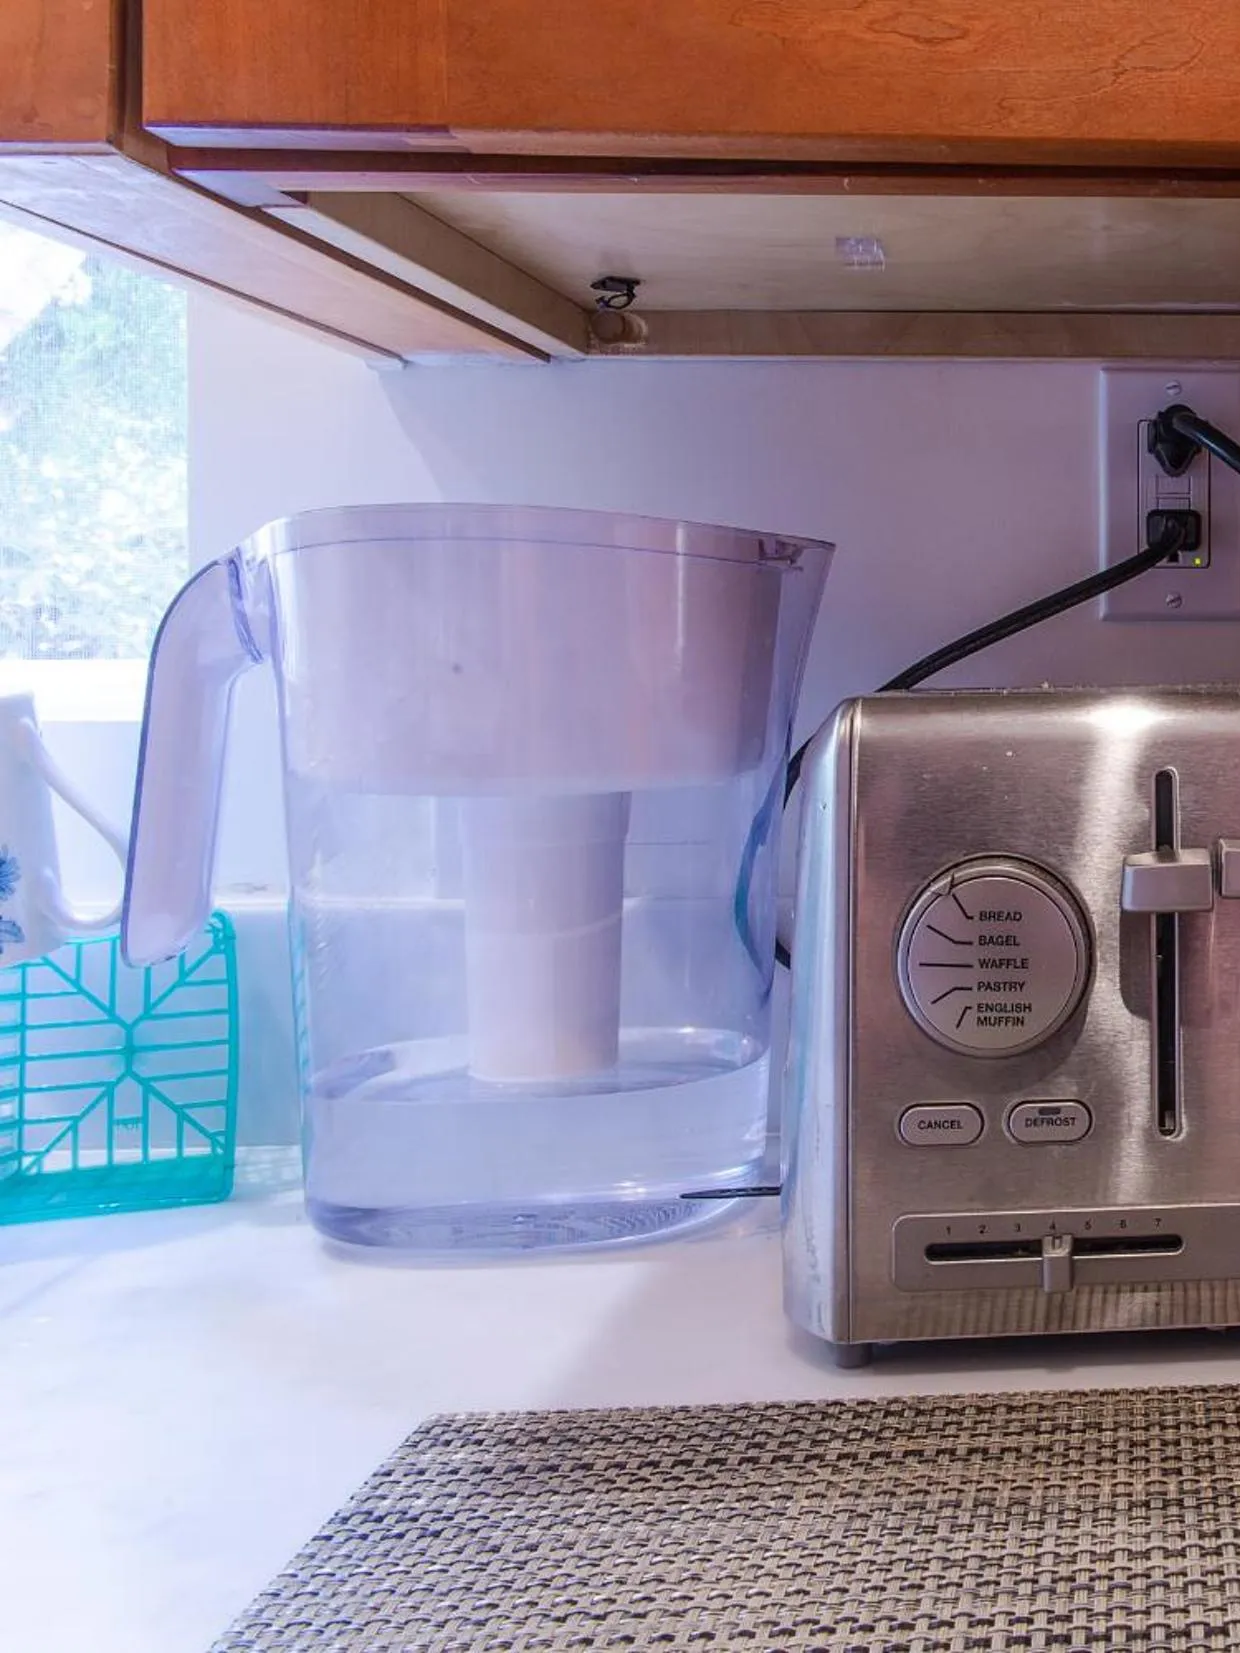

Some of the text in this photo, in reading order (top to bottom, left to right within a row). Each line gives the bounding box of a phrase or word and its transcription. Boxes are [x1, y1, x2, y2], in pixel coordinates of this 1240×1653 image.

[978, 911, 1023, 922] BREAD
[978, 935, 1021, 946] BAGEL
[977, 958, 1029, 969] WAFFLE
[976, 981, 1026, 992] PASTRY
[976, 1003, 1032, 1013] ENGLISH
[976, 1016, 1025, 1027] MUFFIN
[917, 1119, 964, 1130] CANCEL
[1024, 1116, 1077, 1128] DEFROST
